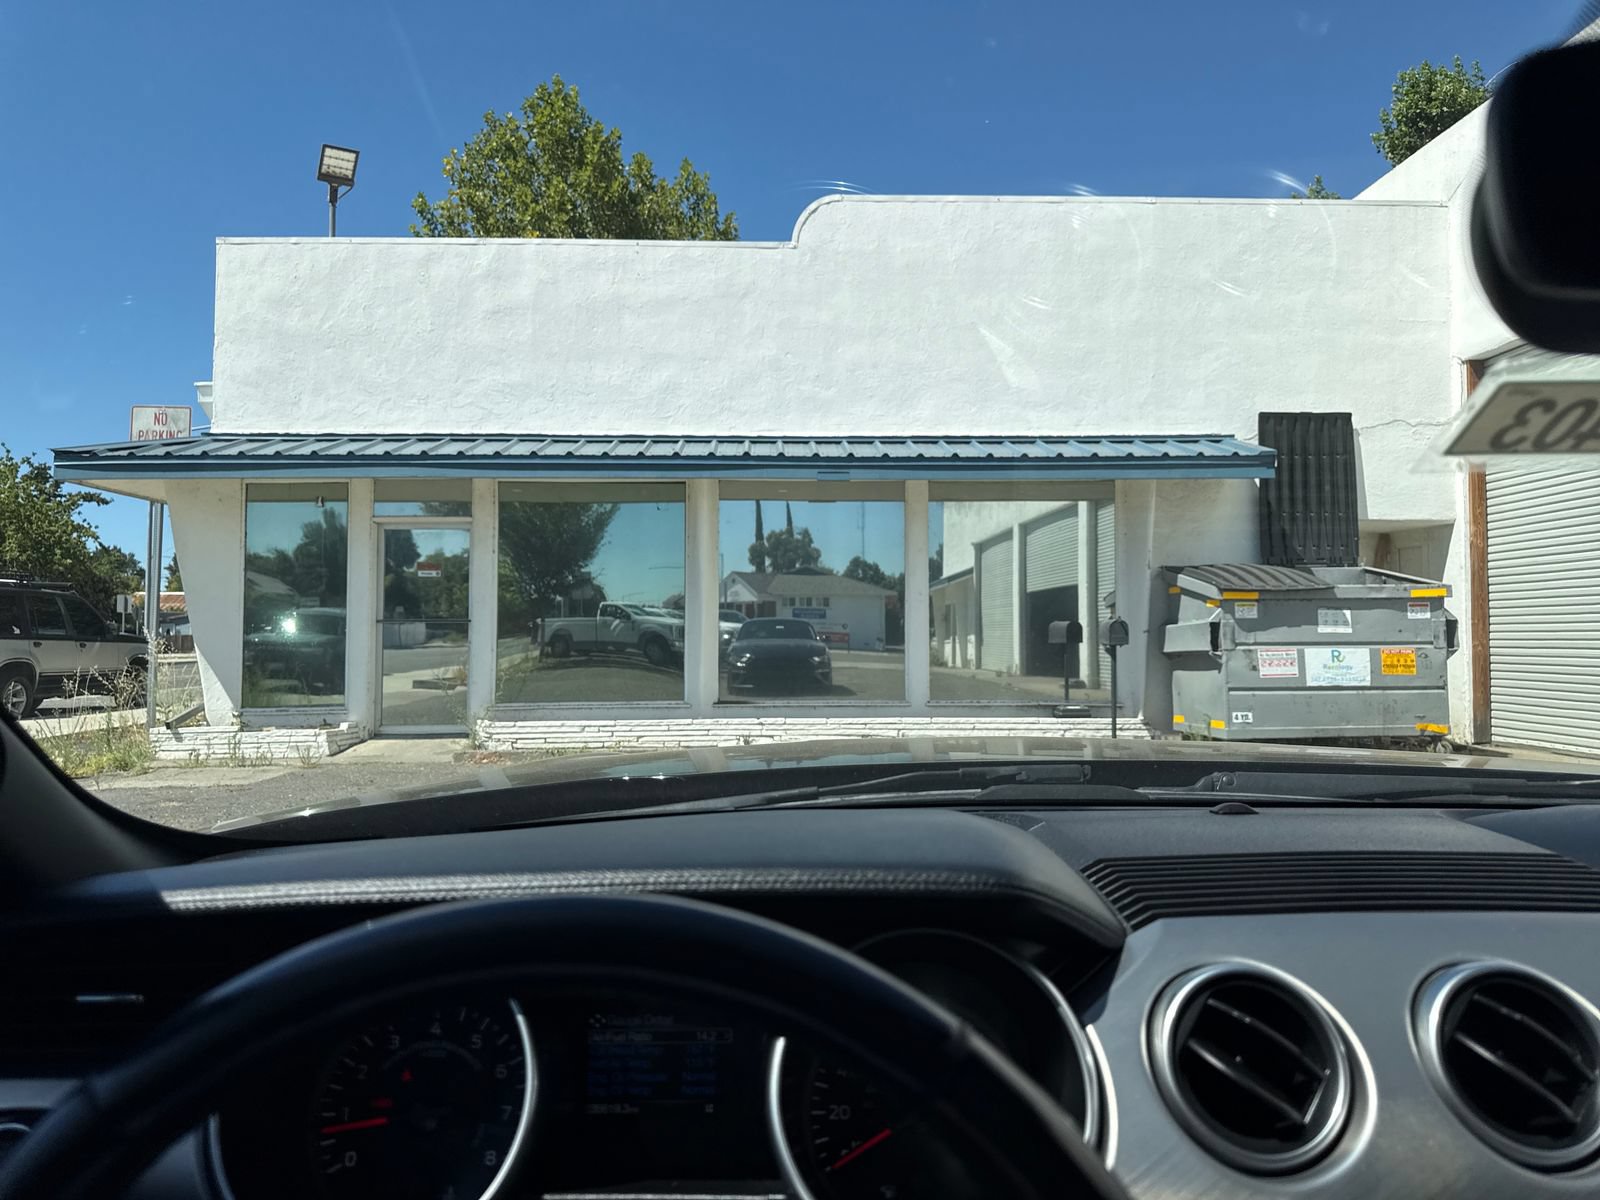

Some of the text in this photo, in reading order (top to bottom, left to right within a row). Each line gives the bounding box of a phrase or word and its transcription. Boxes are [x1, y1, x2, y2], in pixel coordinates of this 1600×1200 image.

[153, 412, 168, 426] NO
[138, 429, 183, 441] PARKING
[1234, 713, 1239, 721] 4
[430, 1021, 442, 1036] 4
[390, 1034, 401, 1050] 3
[471, 1033, 482, 1049] 5
[356, 1064, 368, 1080] 2
[495, 1064, 508, 1079] 6
[500, 1105, 513, 1120] 7
[828, 1104, 852, 1120] 20
[344, 1150, 358, 1167] 0
[484, 1150, 497, 1166] 8
